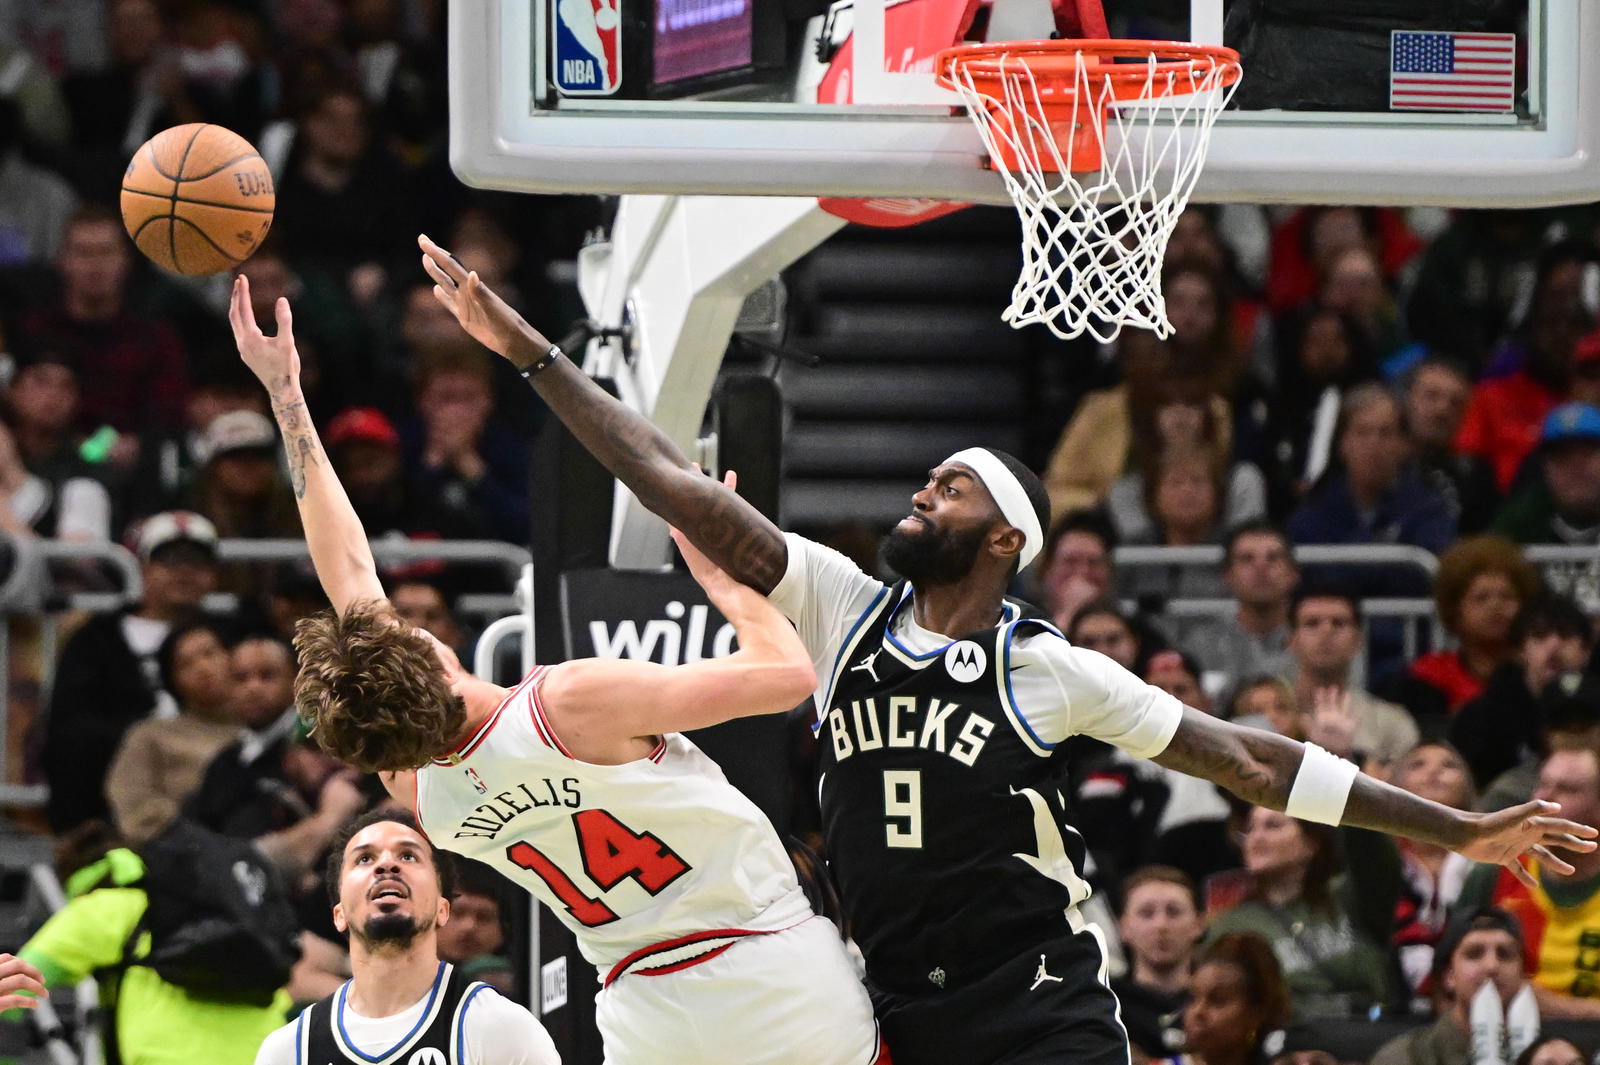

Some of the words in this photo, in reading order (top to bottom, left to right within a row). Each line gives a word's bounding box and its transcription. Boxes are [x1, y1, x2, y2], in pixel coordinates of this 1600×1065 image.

[563, 59, 596, 85] NBA
[829, 696, 995, 768] BUCKS
[883, 770, 922, 849] 9
[506, 808, 693, 928] 14
